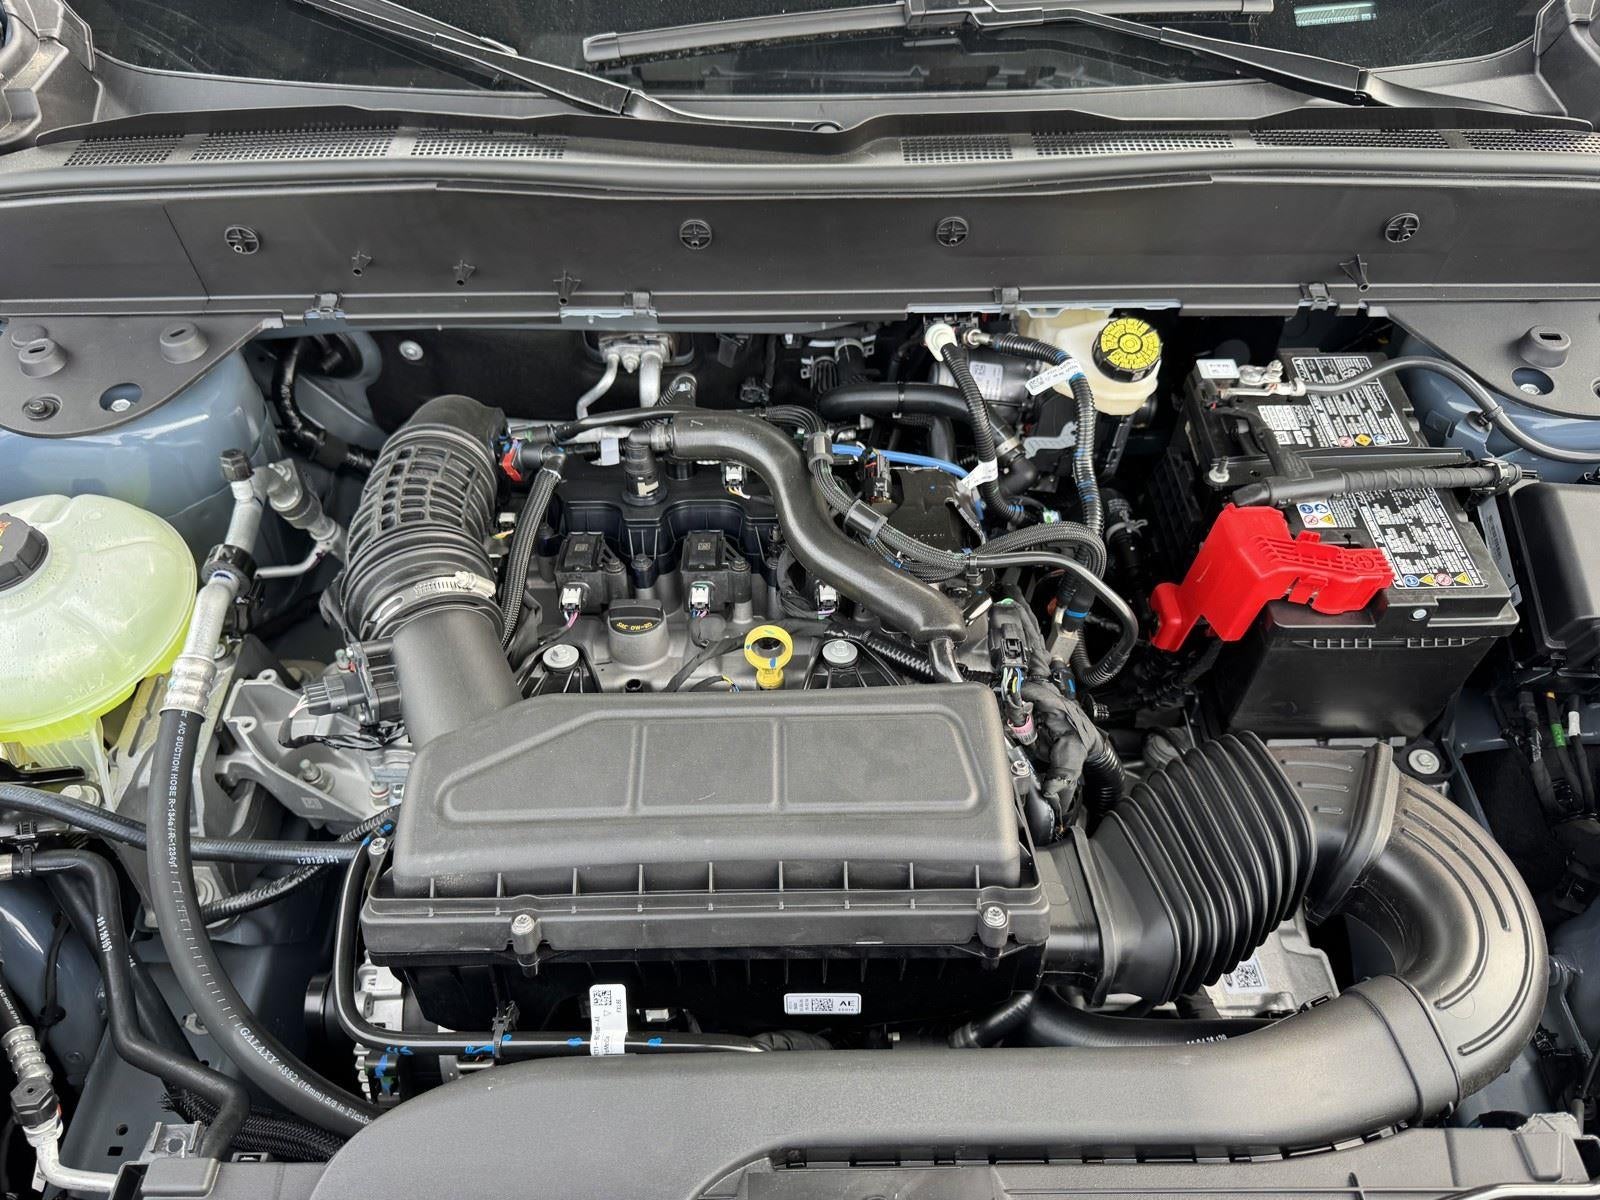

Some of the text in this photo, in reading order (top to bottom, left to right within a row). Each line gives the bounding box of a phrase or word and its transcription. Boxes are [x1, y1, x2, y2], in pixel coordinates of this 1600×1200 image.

[178, 721, 187, 735] A/C
[172, 736, 184, 772] SUCTION
[168, 773, 179, 796] HOSE
[840, 1000, 856, 1008] AE
[240, 1027, 280, 1064] GALAXY
[277, 1064, 299, 1083] 4882
[297, 1080, 325, 1102] (16mm)
[337, 1103, 345, 1113] in
